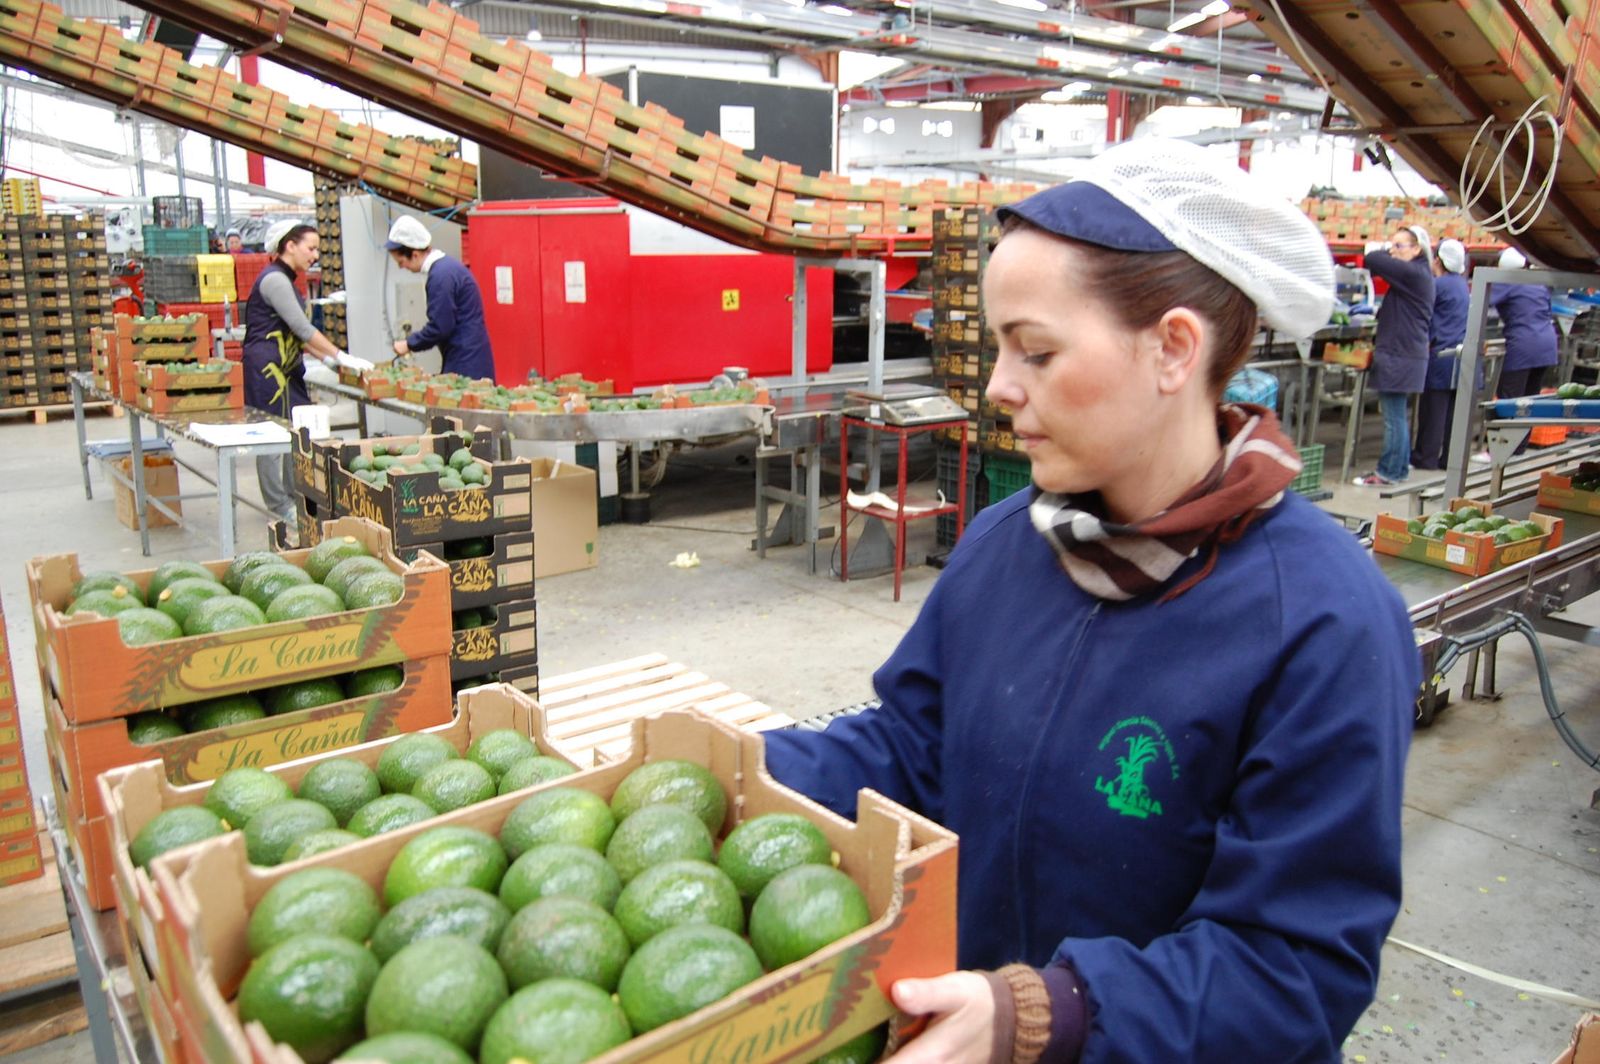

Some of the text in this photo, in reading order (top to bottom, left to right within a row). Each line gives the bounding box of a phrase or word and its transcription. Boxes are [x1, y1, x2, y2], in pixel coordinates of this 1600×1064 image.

[424, 504, 445, 517] LA
[209, 632, 360, 681] La Caña
[215, 722, 361, 774] La Caña
[1094, 775, 1115, 796] LA
